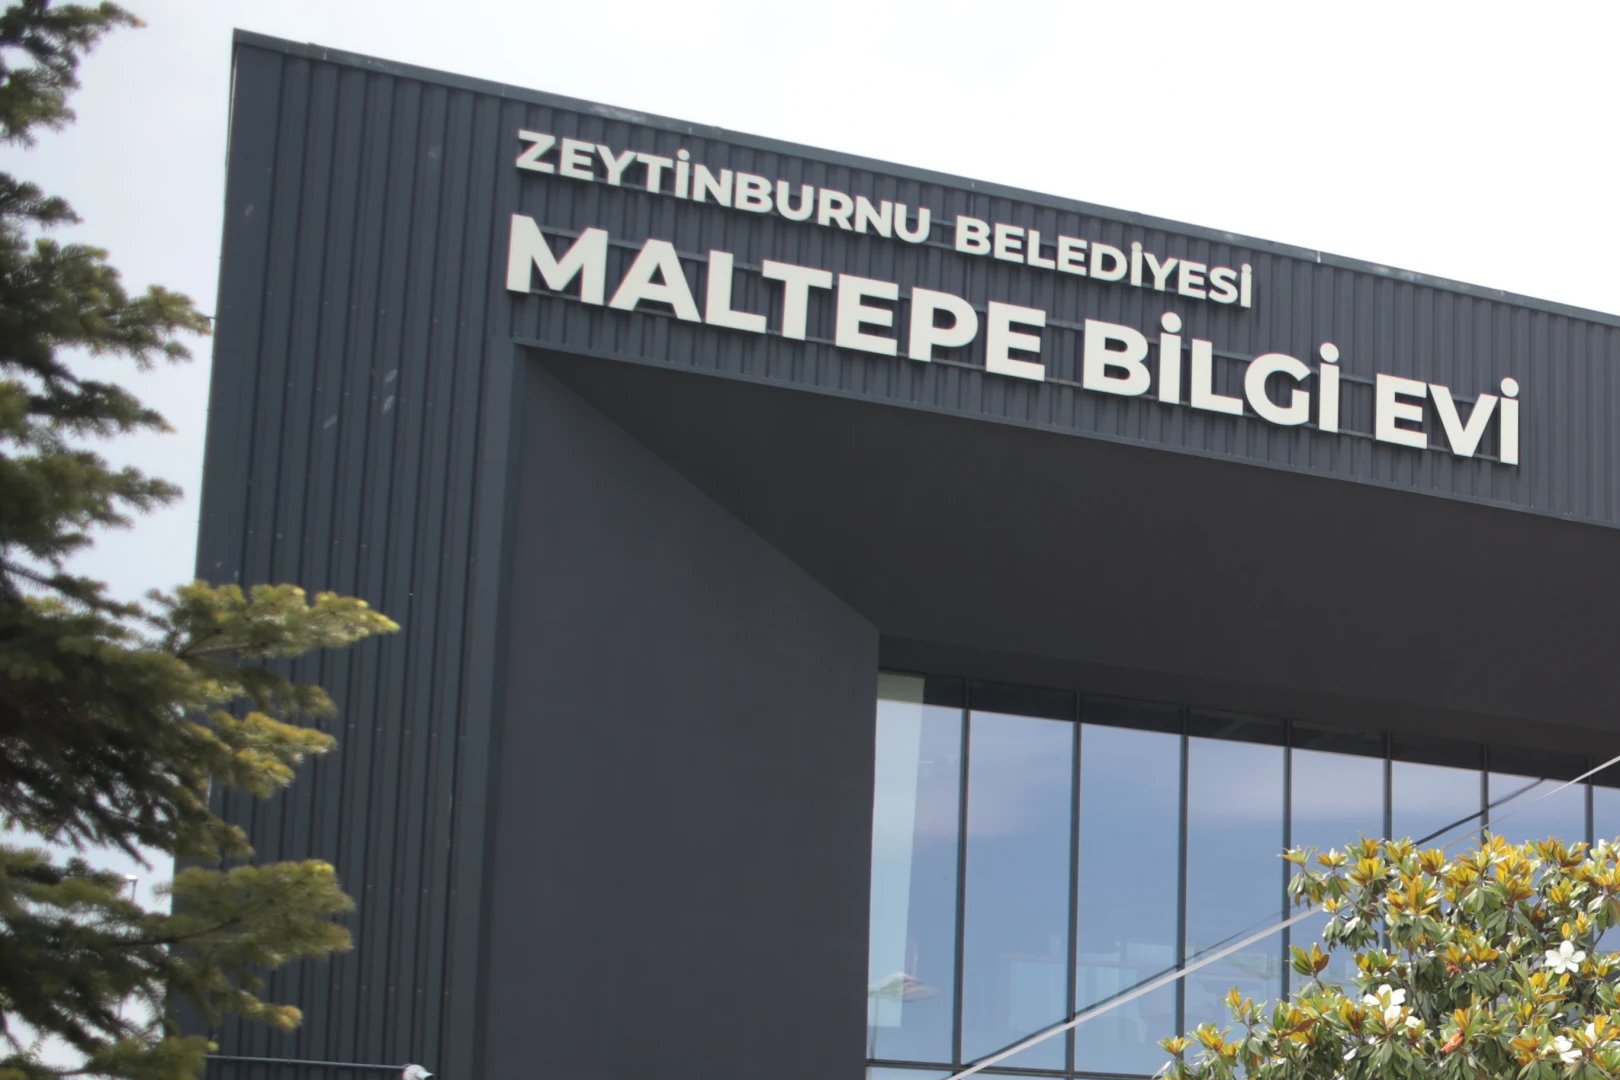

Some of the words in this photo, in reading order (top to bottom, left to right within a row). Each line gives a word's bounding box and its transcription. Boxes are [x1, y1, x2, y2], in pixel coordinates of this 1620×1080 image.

[514, 130, 931, 244] ZEYTİNBURNU
[954, 213, 1252, 309] BELEDİYESİ
[506, 213, 1046, 383] MALTEPE
[1082, 311, 1339, 433] BİLGİ
[1372, 372, 1520, 465] EVİ
